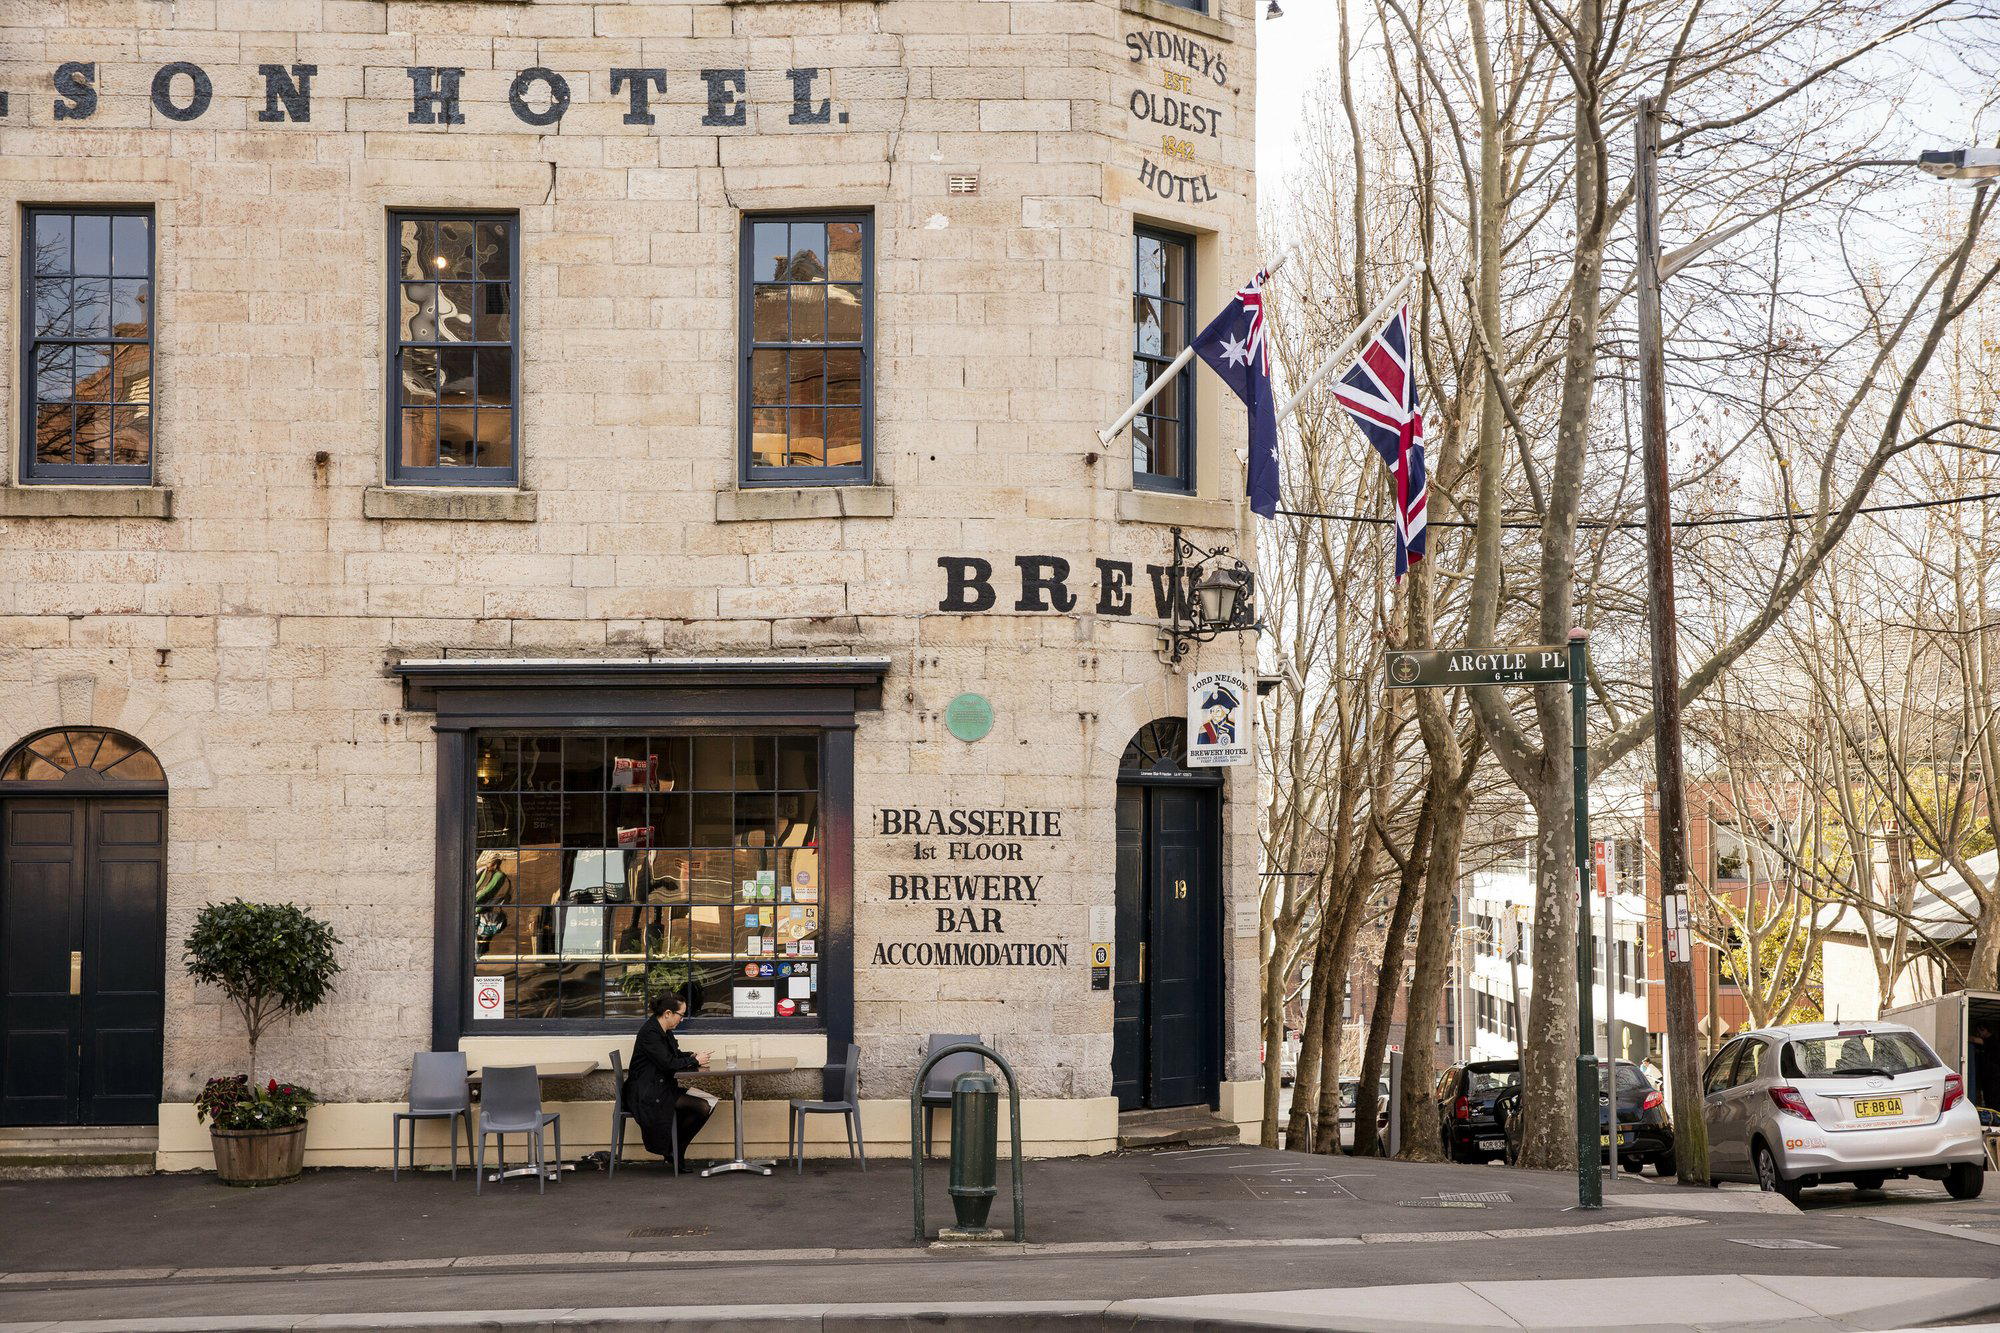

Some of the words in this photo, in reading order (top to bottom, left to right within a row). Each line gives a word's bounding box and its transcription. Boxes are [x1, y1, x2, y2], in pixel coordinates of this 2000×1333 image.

[1125, 31, 1228, 87] SYDNEY'S
[0, 61, 319, 123] SON
[1163, 70, 1192, 95] EST.
[1130, 89, 1222, 138] OLDEST
[1137, 158, 1218, 203] HOTEL
[1448, 653, 1527, 672] ARGYLE
[1540, 652, 1565, 669] PL
[1192, 676, 1213, 692] LORD
[1214, 674, 1248, 691] NELSON
[1495, 672, 1500, 681] 6
[1513, 671, 1523, 680] 14
[1190, 749, 1224, 757] BREWERY
[880, 808, 1062, 837] BRASSERIE
[913, 842, 937, 861] 1st
[948, 842, 1023, 861] FLOOR
[888, 874, 1043, 901] BREWERY
[1174, 879, 1187, 899] 19
[935, 907, 1005, 934] BAR
[1668, 930, 1676, 941] H
[871, 942, 1068, 967] ACCOMMODATION
[1097, 952, 1105, 962] 18
[1669, 950, 1677, 961] P
